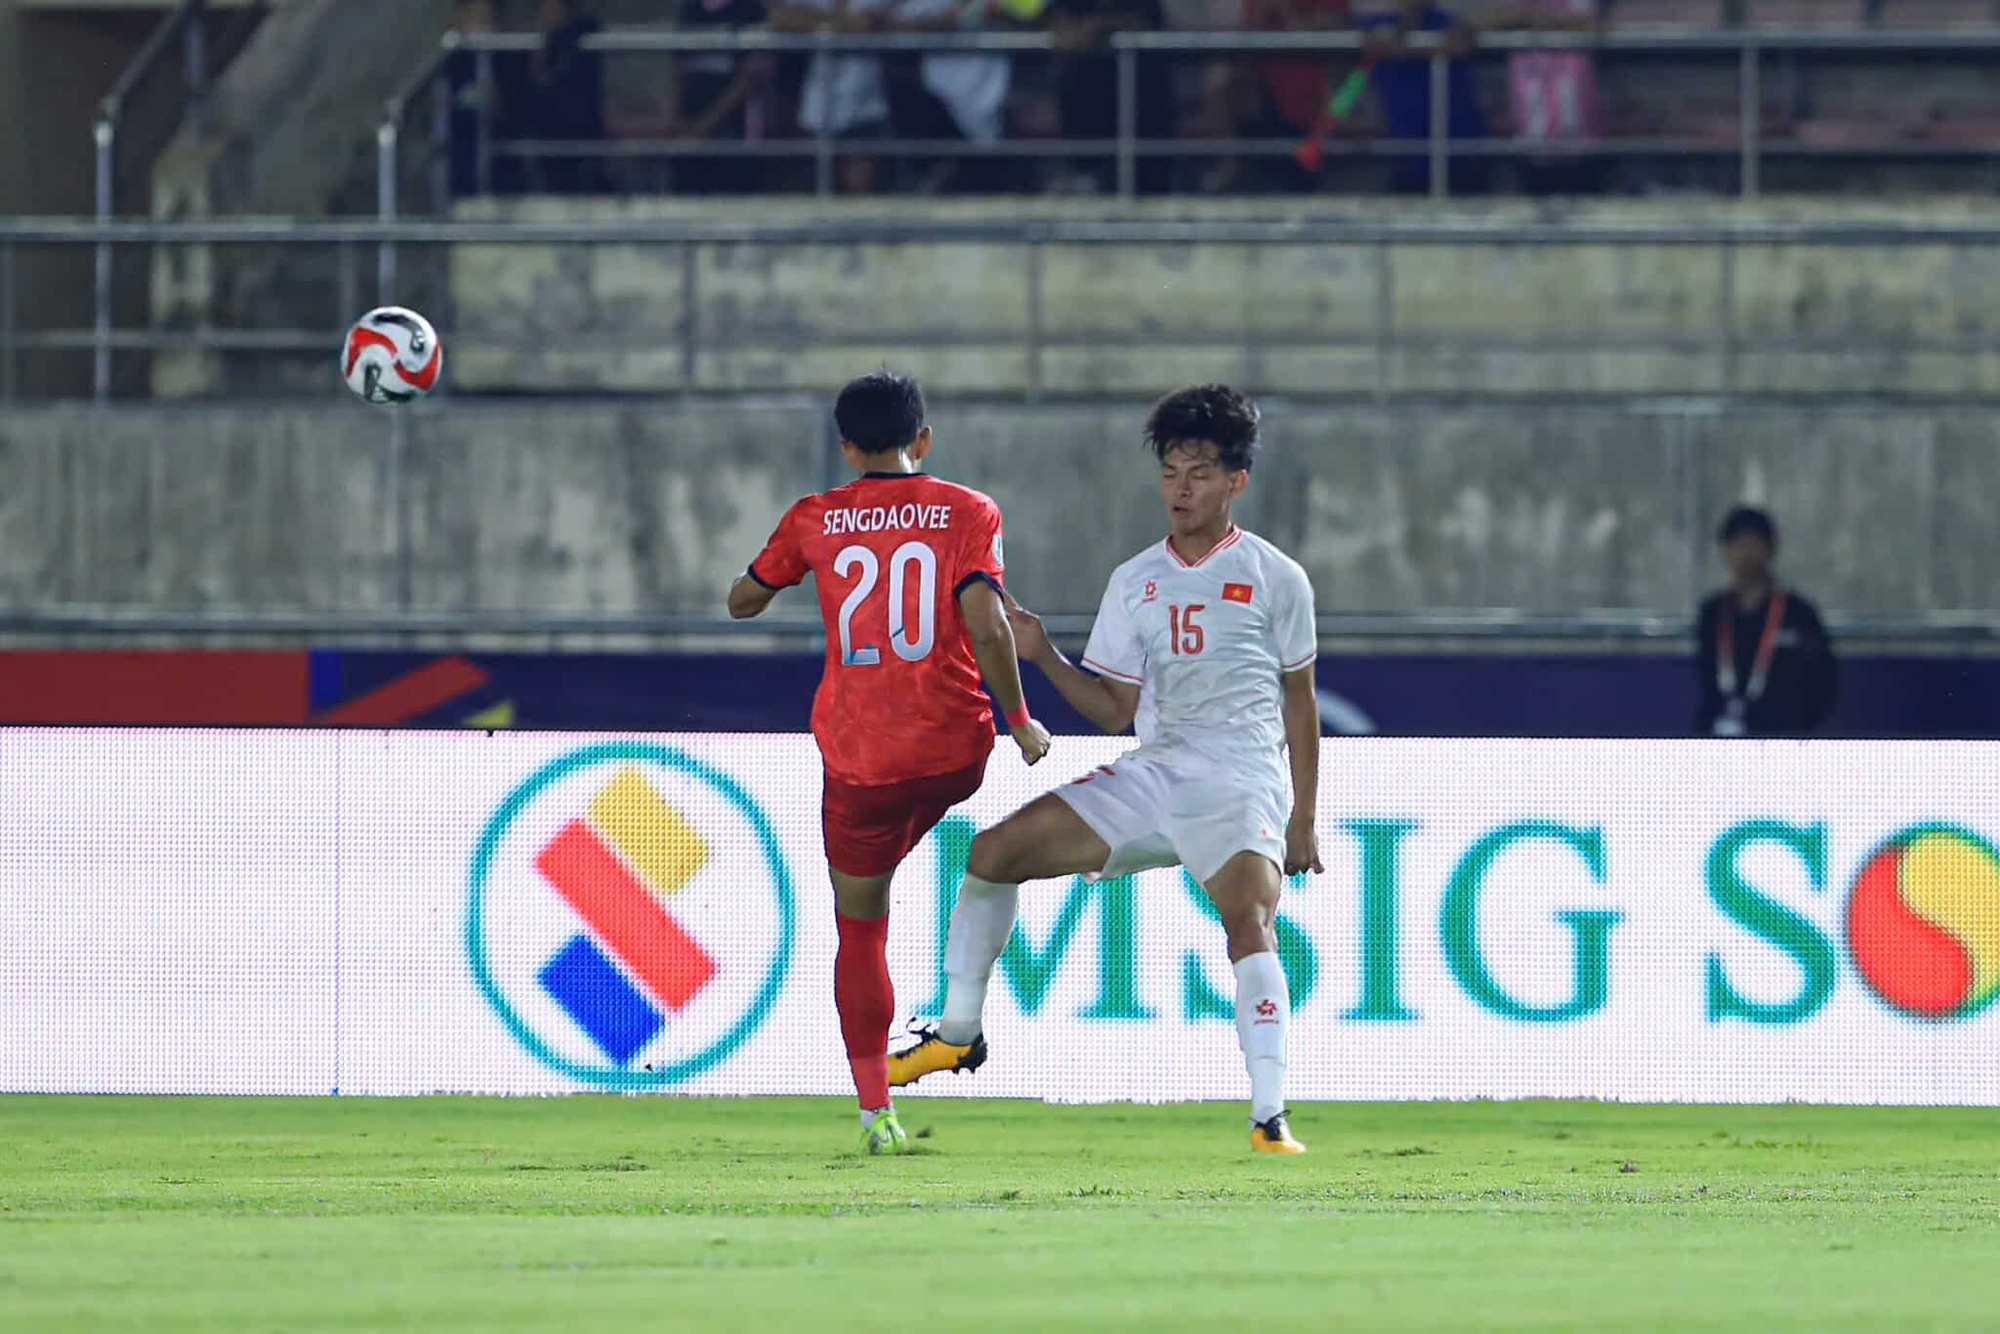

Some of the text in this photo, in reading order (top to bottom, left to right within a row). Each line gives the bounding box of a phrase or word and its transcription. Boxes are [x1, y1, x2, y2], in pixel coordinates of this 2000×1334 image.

[823, 503, 951, 535] SENGDAOVEE
[833, 541, 936, 665] 20
[1169, 604, 1205, 655] 15
